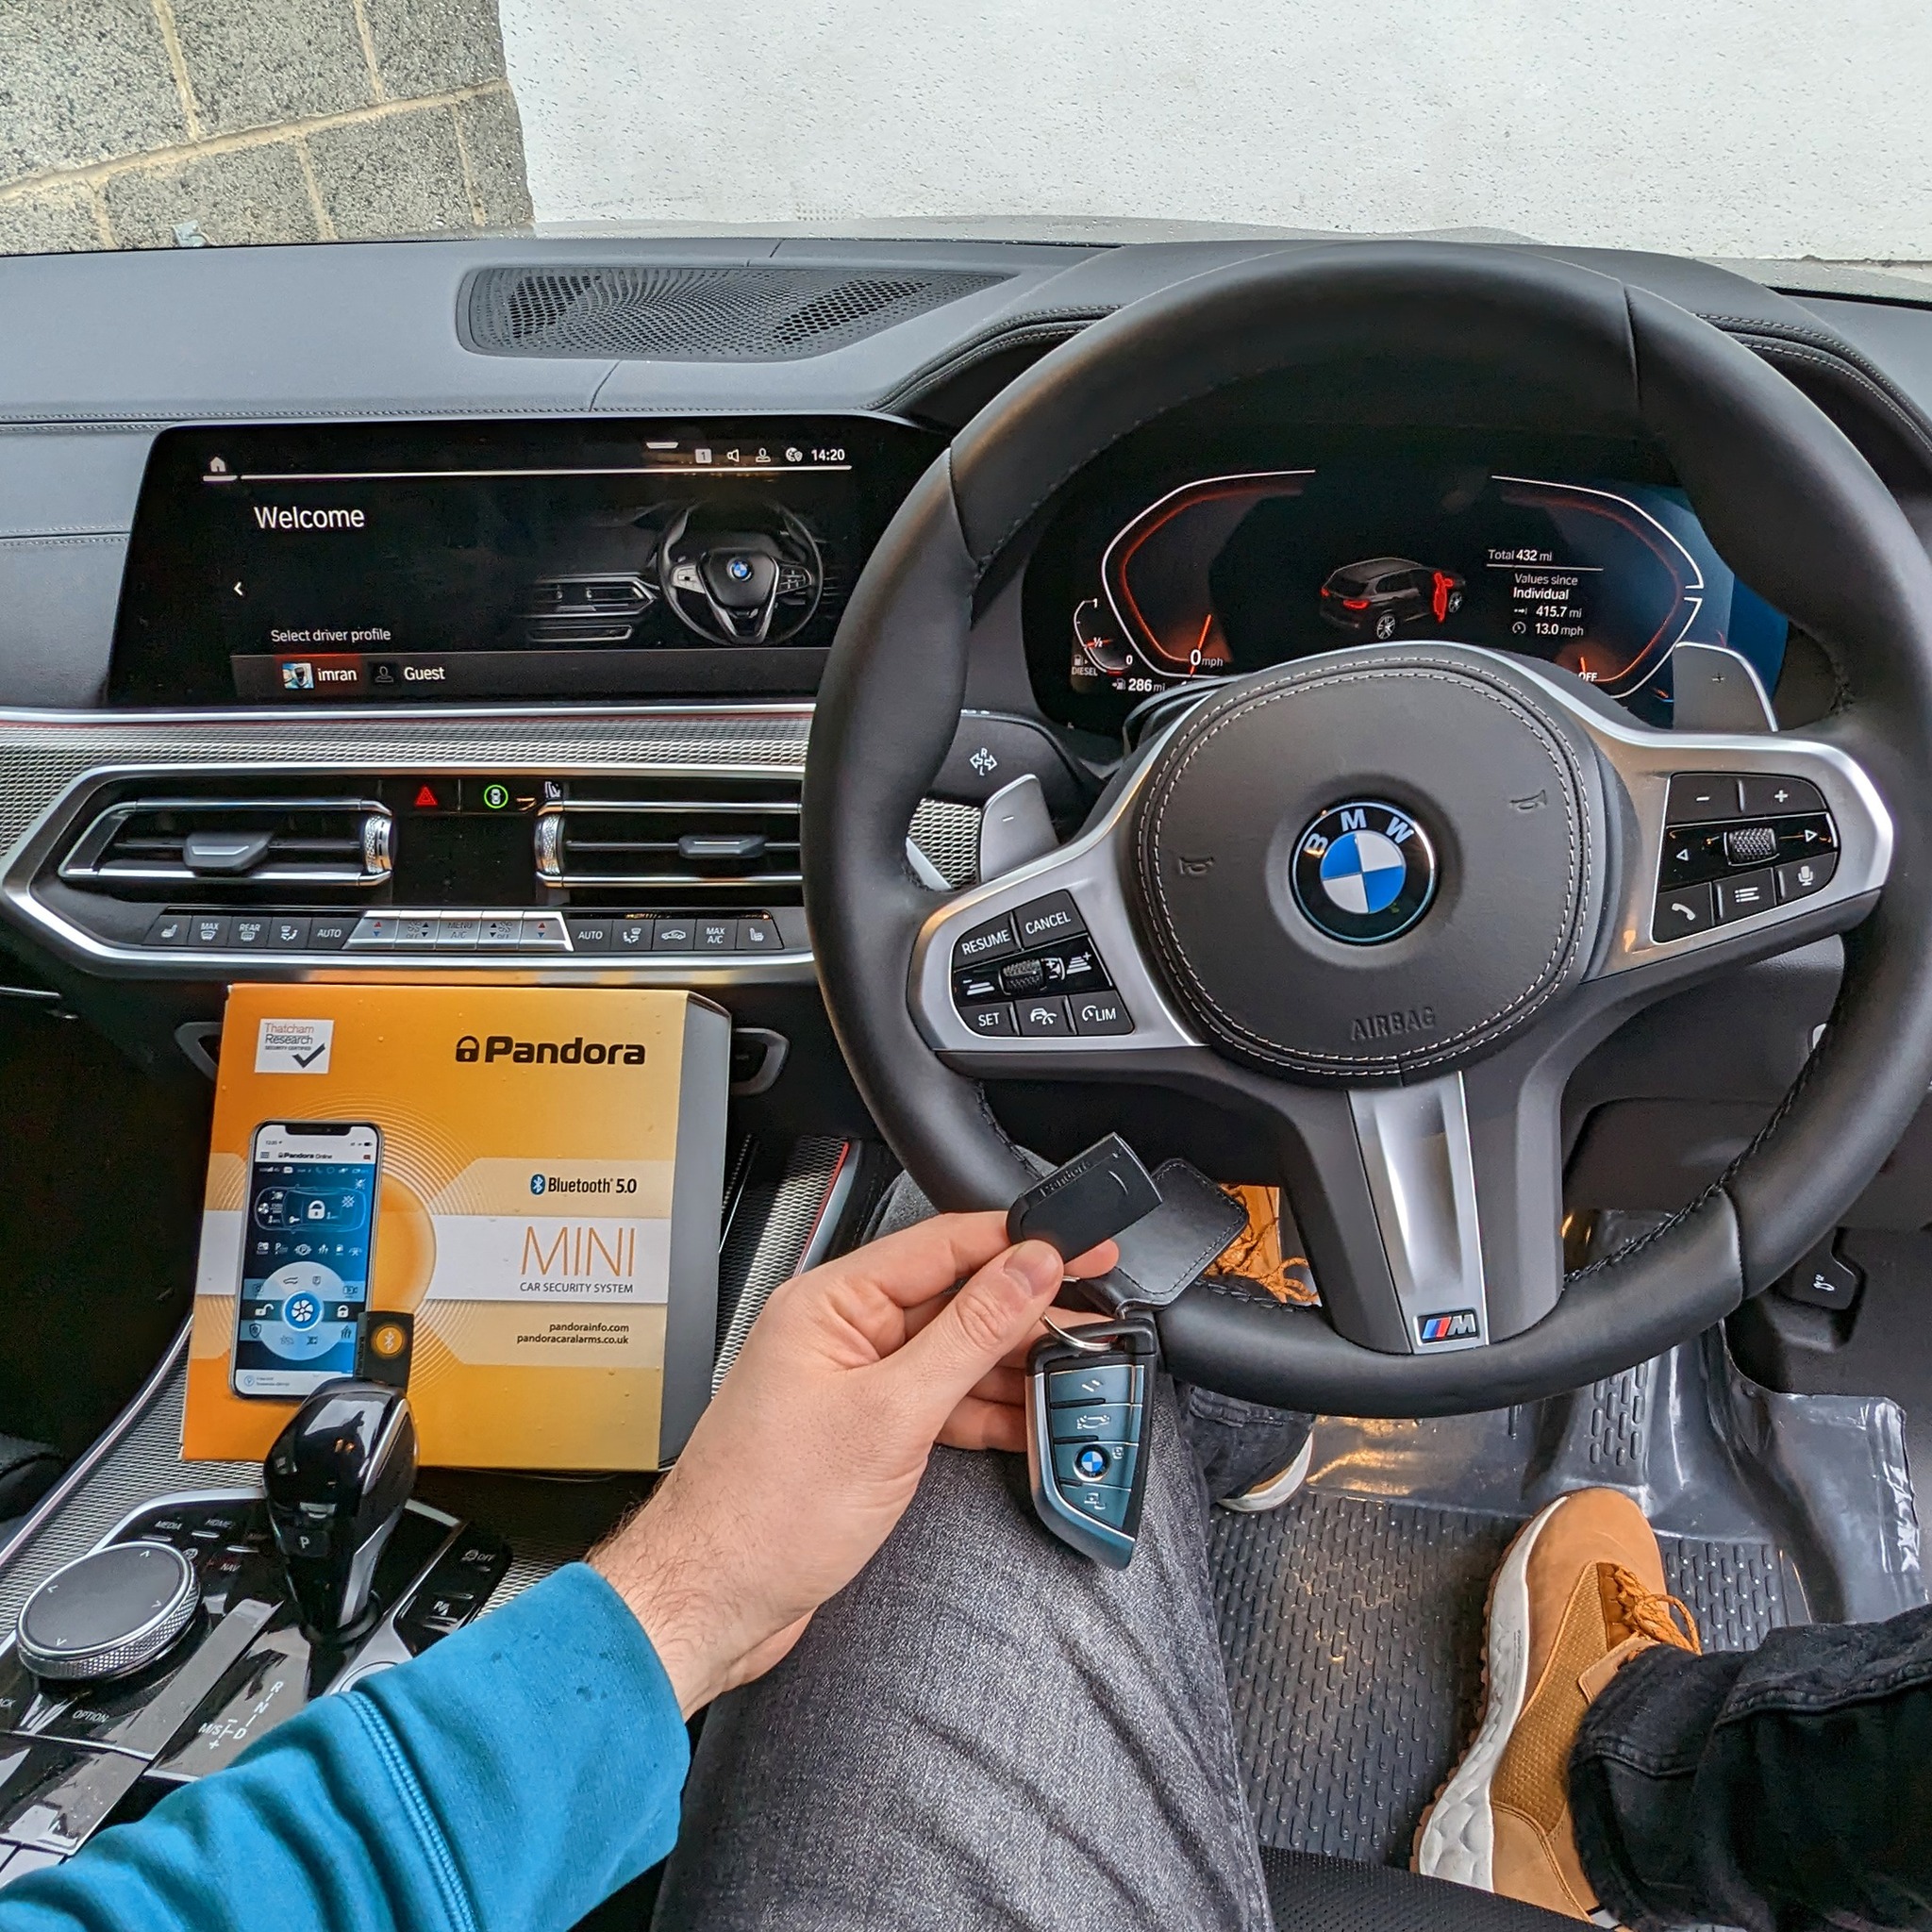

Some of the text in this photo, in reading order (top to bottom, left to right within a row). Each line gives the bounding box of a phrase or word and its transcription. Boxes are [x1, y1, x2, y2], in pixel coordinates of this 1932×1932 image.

[811, 448, 845, 461] 14:20
[254, 507, 365, 529] Welcome
[1488, 549, 1553, 561] Total 432 mi
[1514, 574, 1578, 586] Values since
[1513, 587, 1570, 600] Individual
[1536, 607, 1582, 619] 415.7 mi
[271, 627, 391, 642] Select driver profile
[1535, 623, 1584, 637] 13.0 mph
[1190, 649, 1224, 668] 0 mph
[318, 666, 446, 681] imran Guest
[1071, 666, 1098, 676] DIESEL
[1127, 678, 1166, 691] 286 mi
[1304, 808, 1415, 858] BMW
[201, 922, 219, 931] MAX
[239, 923, 261, 932] REAR
[1024, 910, 1072, 935] CANCEL
[317, 928, 342, 939] AUTO
[578, 930, 603, 941] AUTO
[707, 926, 725, 936] MAX
[708, 935, 724, 944] A/C
[961, 929, 1011, 956] RESUME
[977, 1012, 1000, 1027] SET
[1095, 1008, 1117, 1022] LIM
[265, 1023, 314, 1033] Thatcham
[1351, 1006, 1436, 1041] AIRBAG
[265, 1033, 313, 1044] Research
[485, 1036, 645, 1065] Pandora
[616, 1178, 638, 1193] 5.0
[521, 1226, 635, 1276] MINI
[520, 1282, 634, 1293] CAR SECURITY SYSTEM
[549, 1323, 630, 1333] pandorainfo.com
[517, 1334, 629, 1344] pandoracaralarms.co.uk
[155, 1520, 182, 1531] MEDIA
[205, 1519, 232, 1529] HOME
[299, 1536, 310, 1549] P
[220, 1562, 241, 1573] NAV
[270, 1681, 284, 1693] R
[254, 1701, 270, 1714] N
[72, 1709, 110, 1724] OPTION
[198, 1723, 224, 1736] M/S
